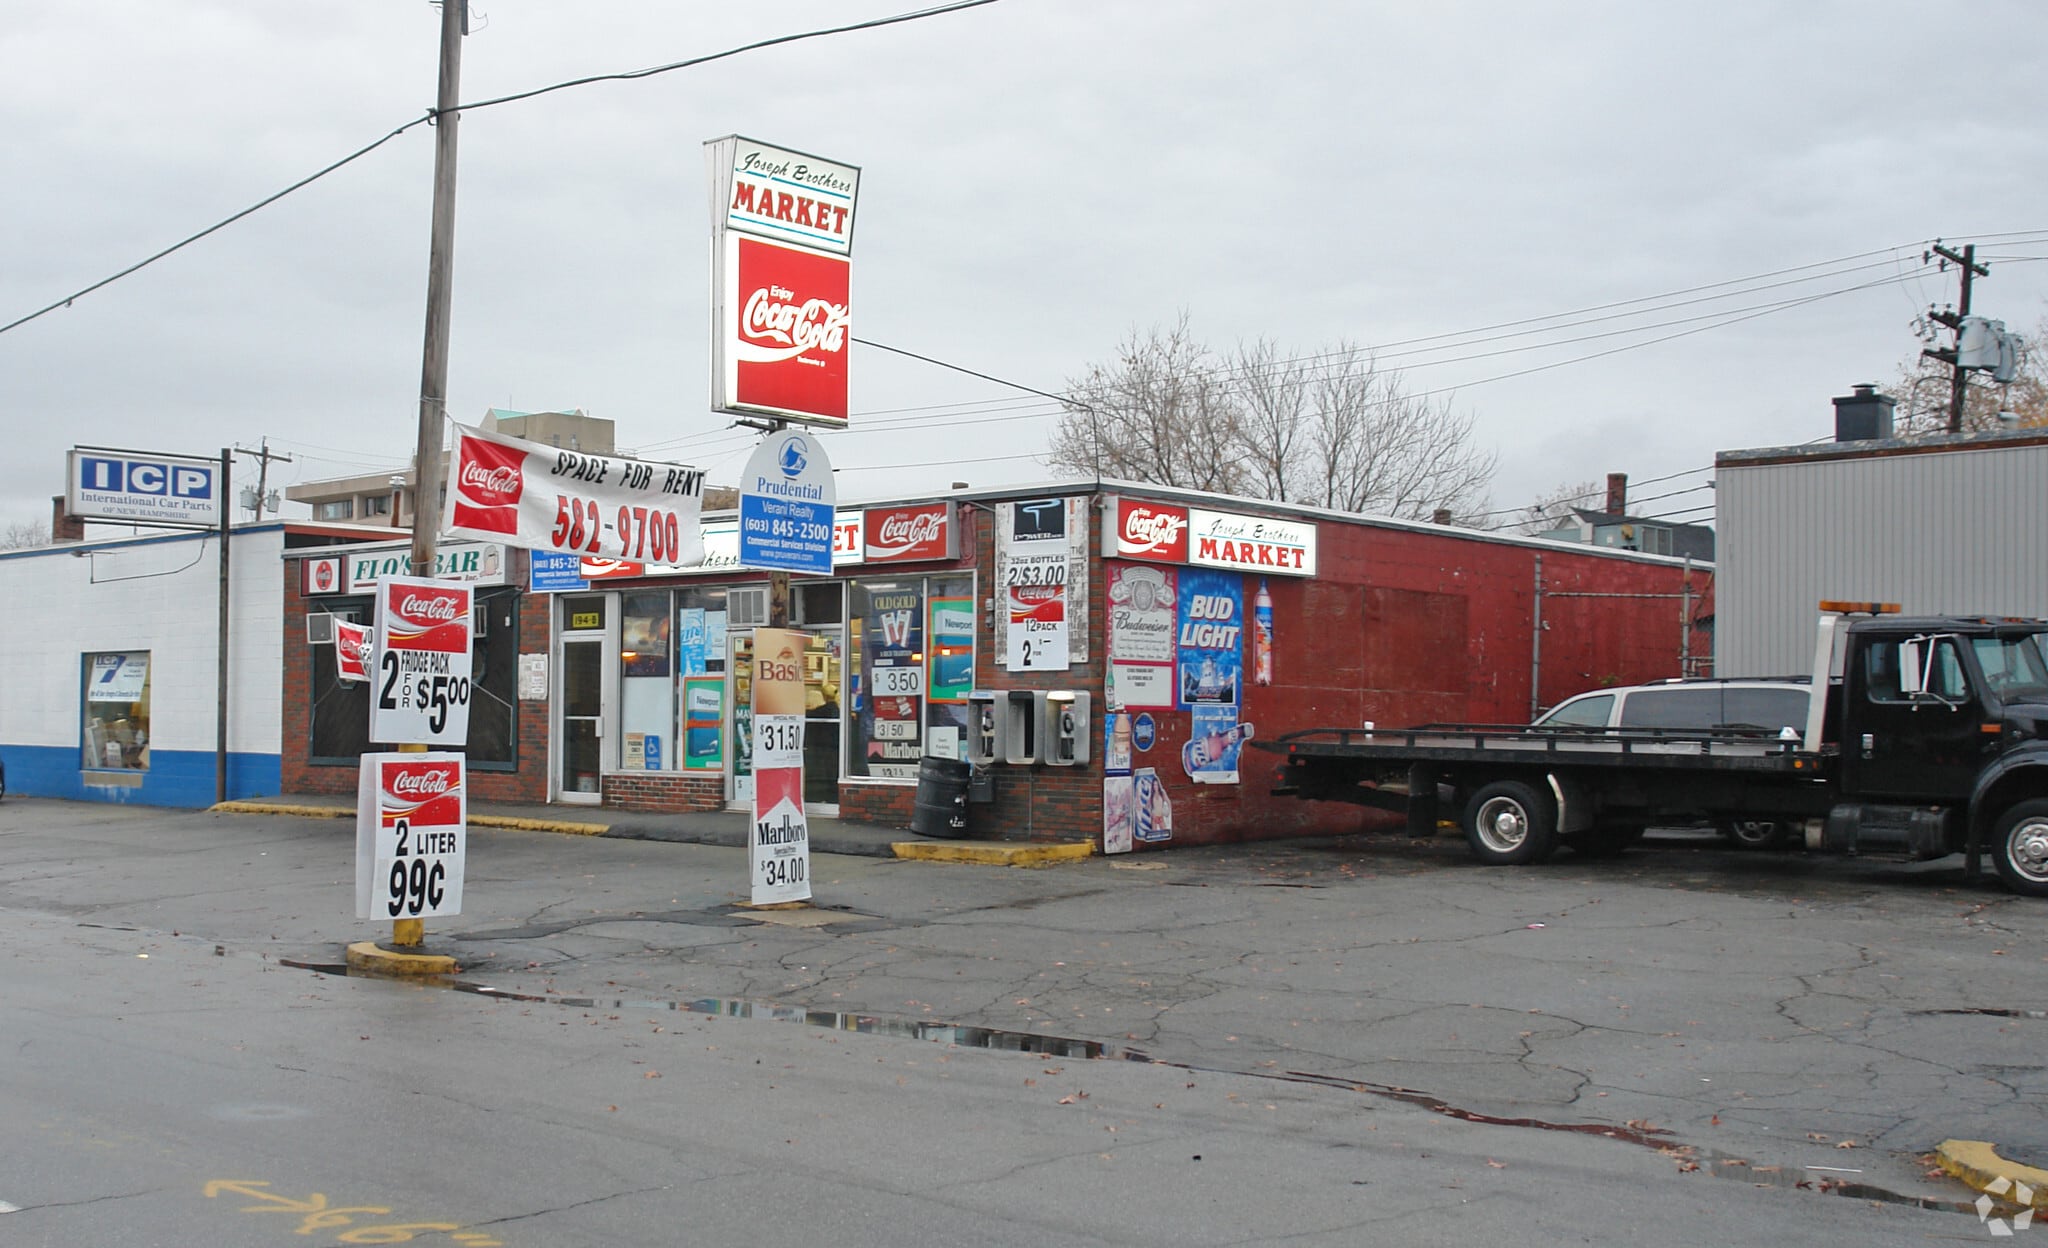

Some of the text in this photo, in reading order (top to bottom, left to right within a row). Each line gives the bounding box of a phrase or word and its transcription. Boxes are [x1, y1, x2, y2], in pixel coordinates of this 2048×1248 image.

[740, 151, 851, 193] Joseph Brothers
[732, 180, 849, 235] MARKET
[770, 285, 795, 302] Enjoy
[95, 462, 208, 496] ICP
[551, 451, 705, 497] SPACE FOR RENT
[81, 492, 212, 512] International Car Parts
[757, 476, 823, 501] Prudential
[102, 506, 192, 520] OF NEW HAMPSHIRE
[761, 500, 815, 521] Verani Realty
[552, 494, 679, 563] 582-9700
[745, 517, 769, 533] (603)
[772, 518, 829, 541] 845-2500
[1210, 518, 1299, 543] Joseph Brothers
[1030, 555, 1065, 564] BOTTLES
[1199, 537, 1305, 569] MARKET
[875, 595, 916, 610] OLD GOLD
[1189, 594, 1234, 620] BUD
[1114, 610, 1169, 633] Budweiser
[1180, 623, 1240, 651] LIGHT
[401, 651, 450, 675] FRIDGE PACK
[1022, 639, 1032, 666] 2
[379, 650, 400, 710] 2
[759, 659, 803, 682] Basic
[760, 724, 801, 751] $31.50
[395, 819, 456, 857] 2 LITER
[757, 814, 806, 846] Marlboro
[760, 856, 805, 886] $34.00
[388, 858, 445, 917] 99¢
